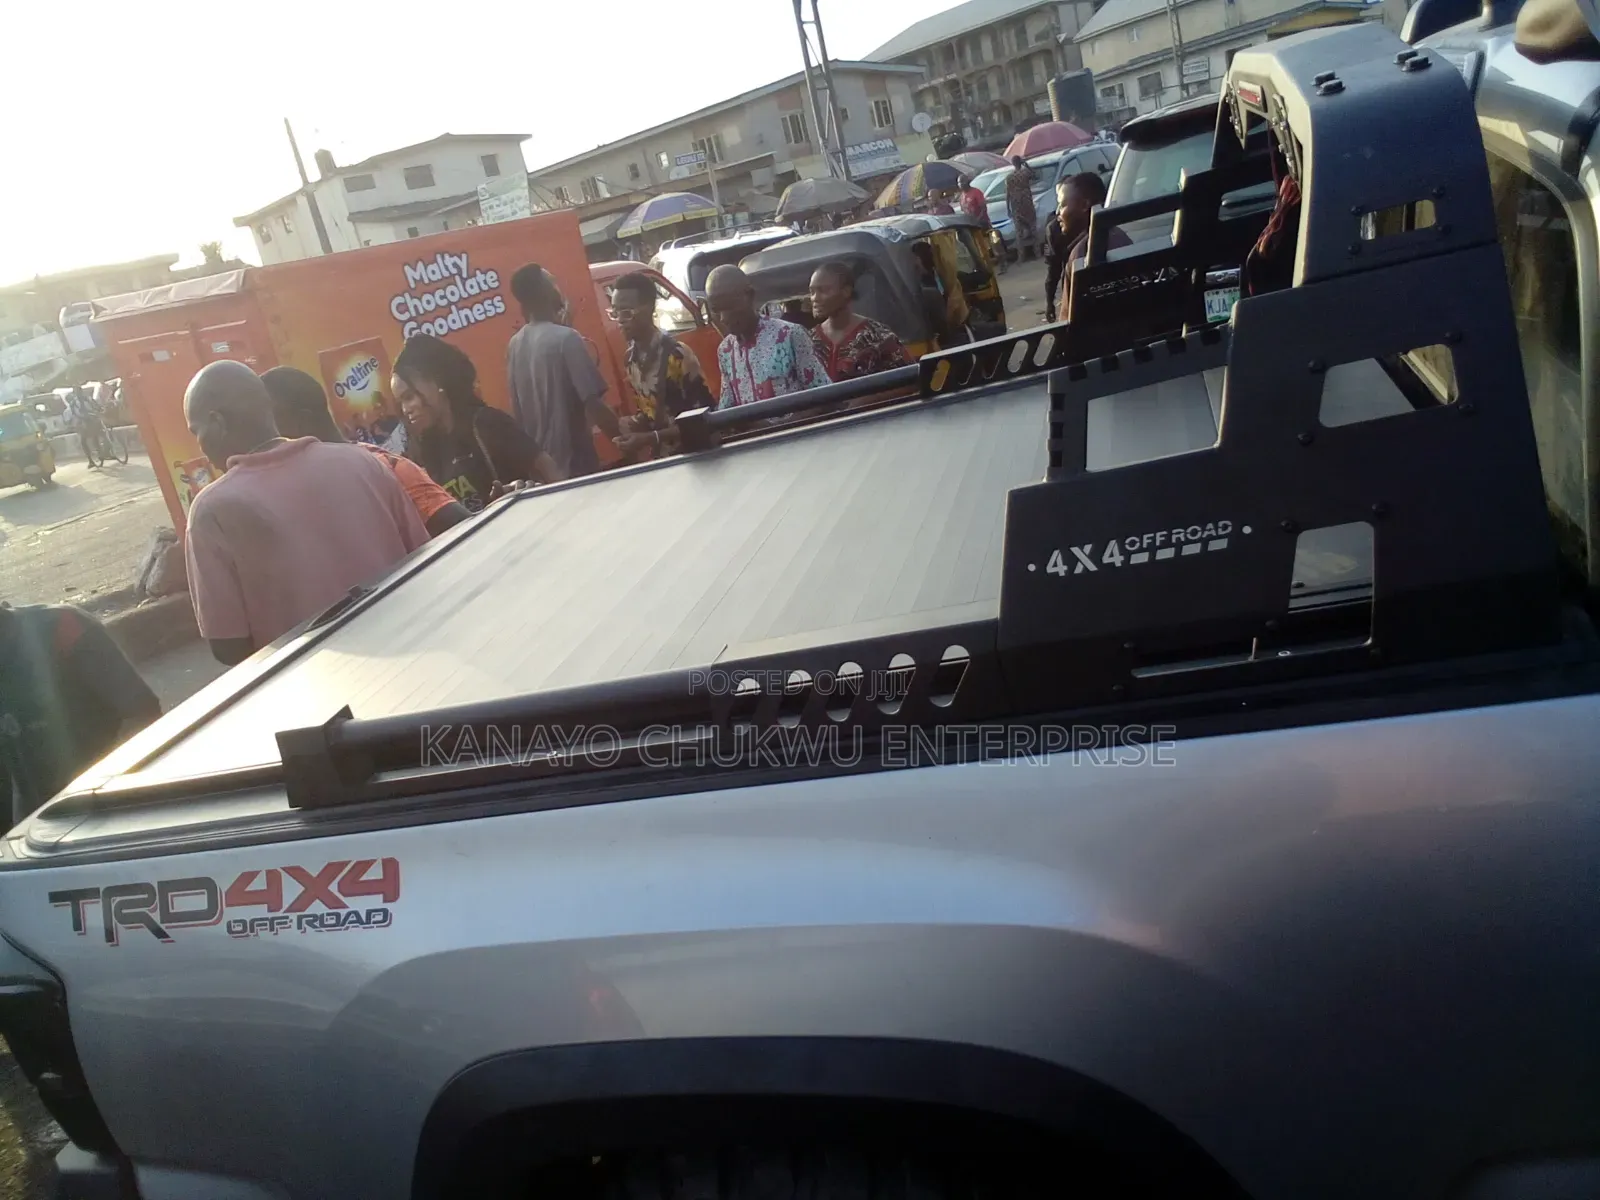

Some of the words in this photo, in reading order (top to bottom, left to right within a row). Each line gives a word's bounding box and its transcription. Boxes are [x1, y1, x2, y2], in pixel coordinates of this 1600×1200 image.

[404, 253, 468, 288] Malty
[390, 269, 499, 321] Chocolate
[403, 295, 505, 338] Goodness
[334, 356, 378, 398] Ovaltine
[1046, 539, 1125, 576] 4X4
[1125, 531, 1168, 550] OFF
[1171, 520, 1233, 544] ROAD
[48, 876, 225, 947] TRD
[225, 857, 400, 914] 4X4
[226, 914, 292, 939] OFF
[296, 907, 393, 934] ROAD
